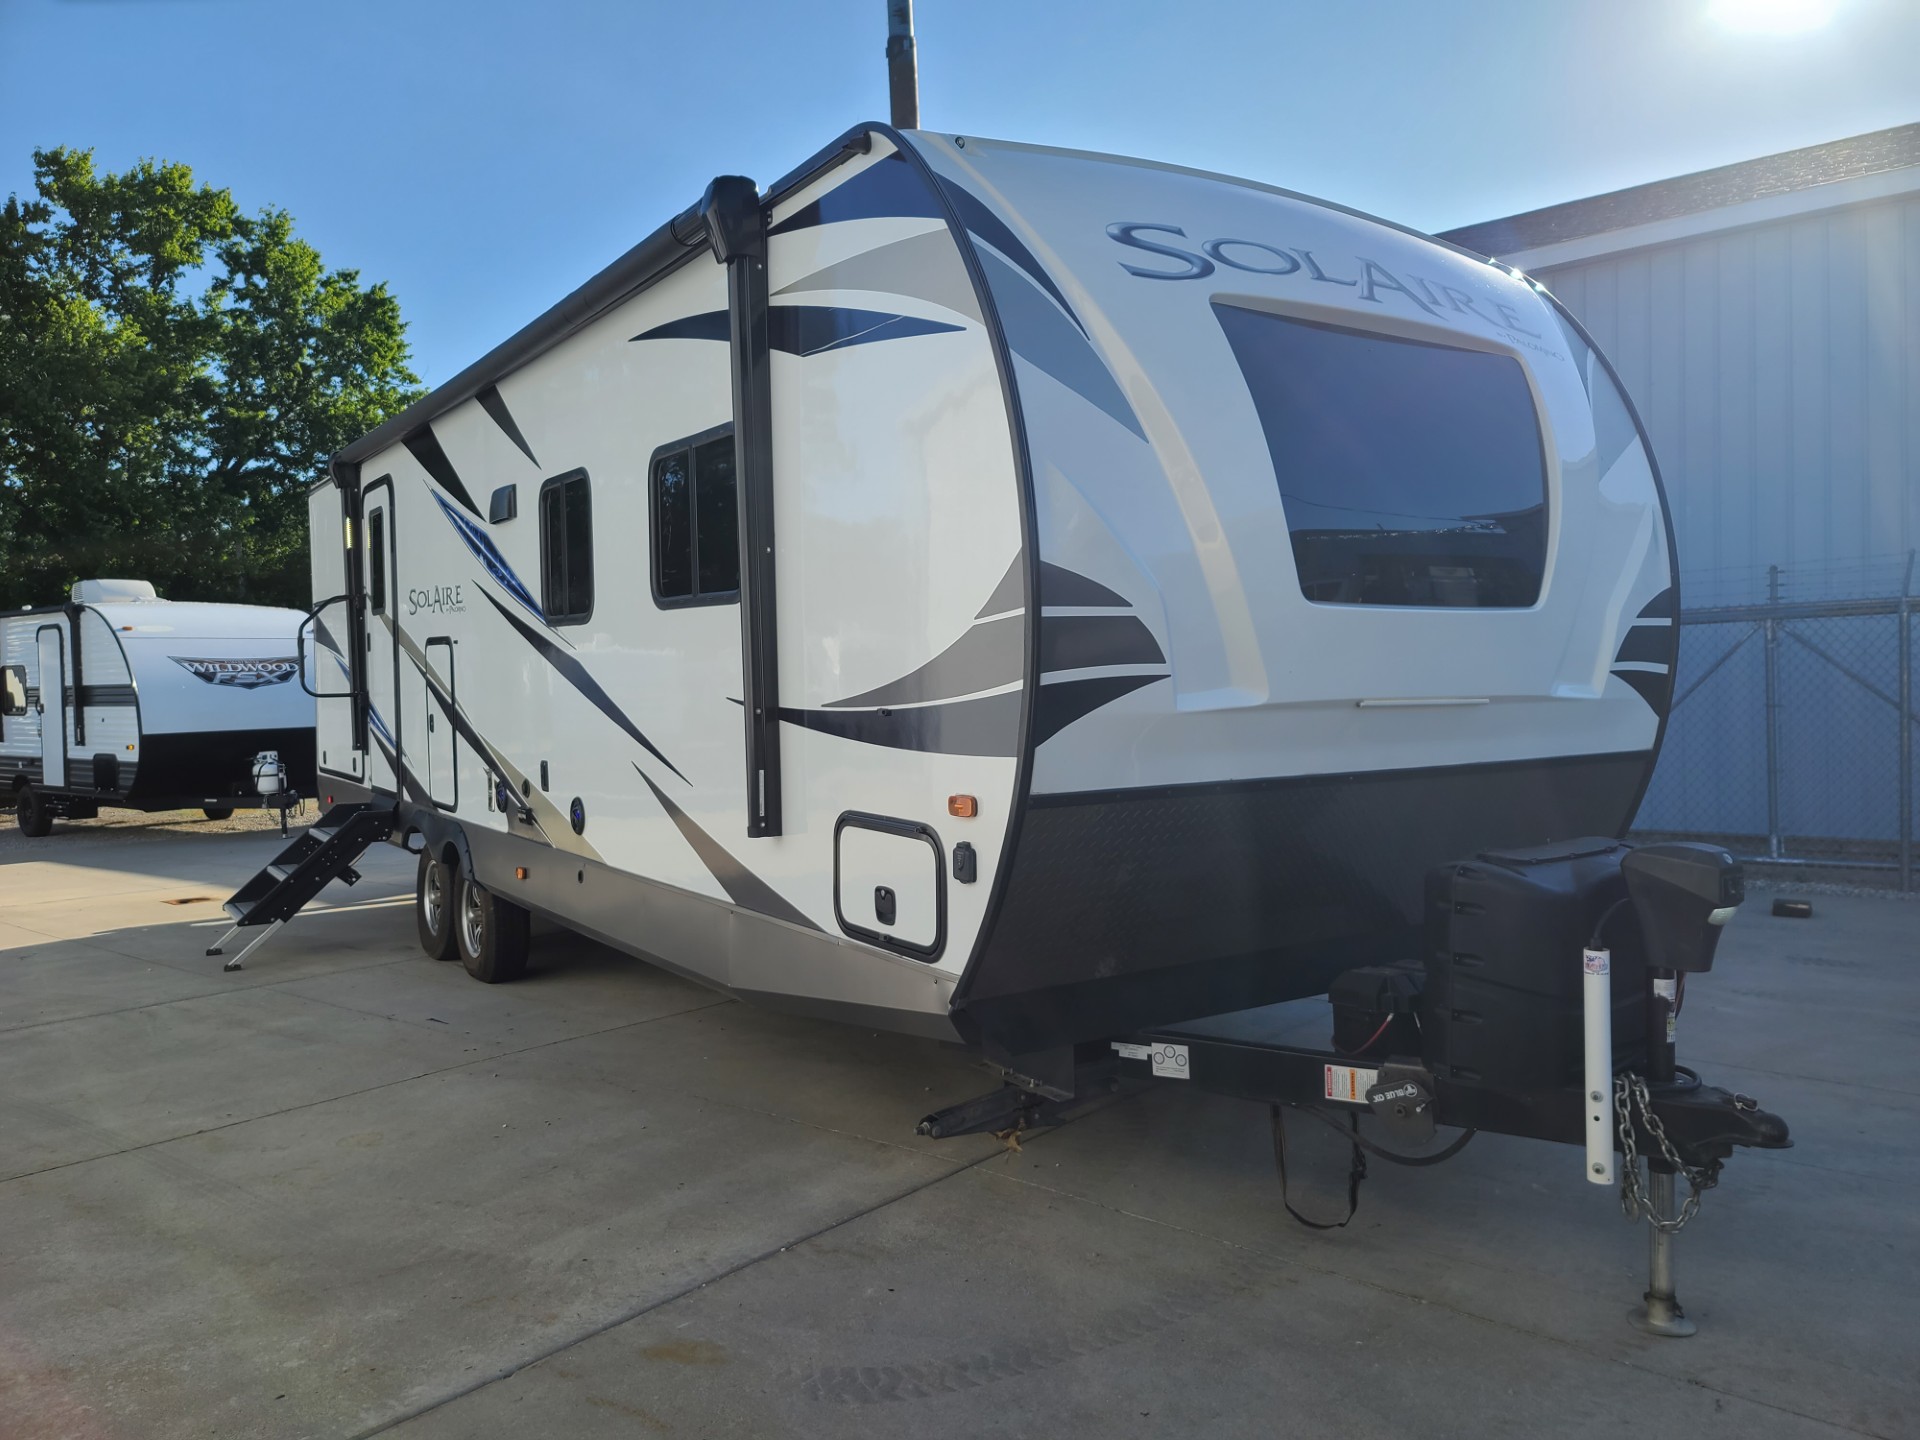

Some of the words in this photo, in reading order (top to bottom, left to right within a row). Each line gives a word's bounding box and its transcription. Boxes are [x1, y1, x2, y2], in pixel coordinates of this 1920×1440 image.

[1106, 221, 1541, 339] SOLAIRE
[409, 585, 463, 615] SOLAIRE
[182, 662, 299, 672] WILDWOOD
[1372, 1094, 1385, 1102] OX
[1385, 1088, 1405, 1100] BLUE
